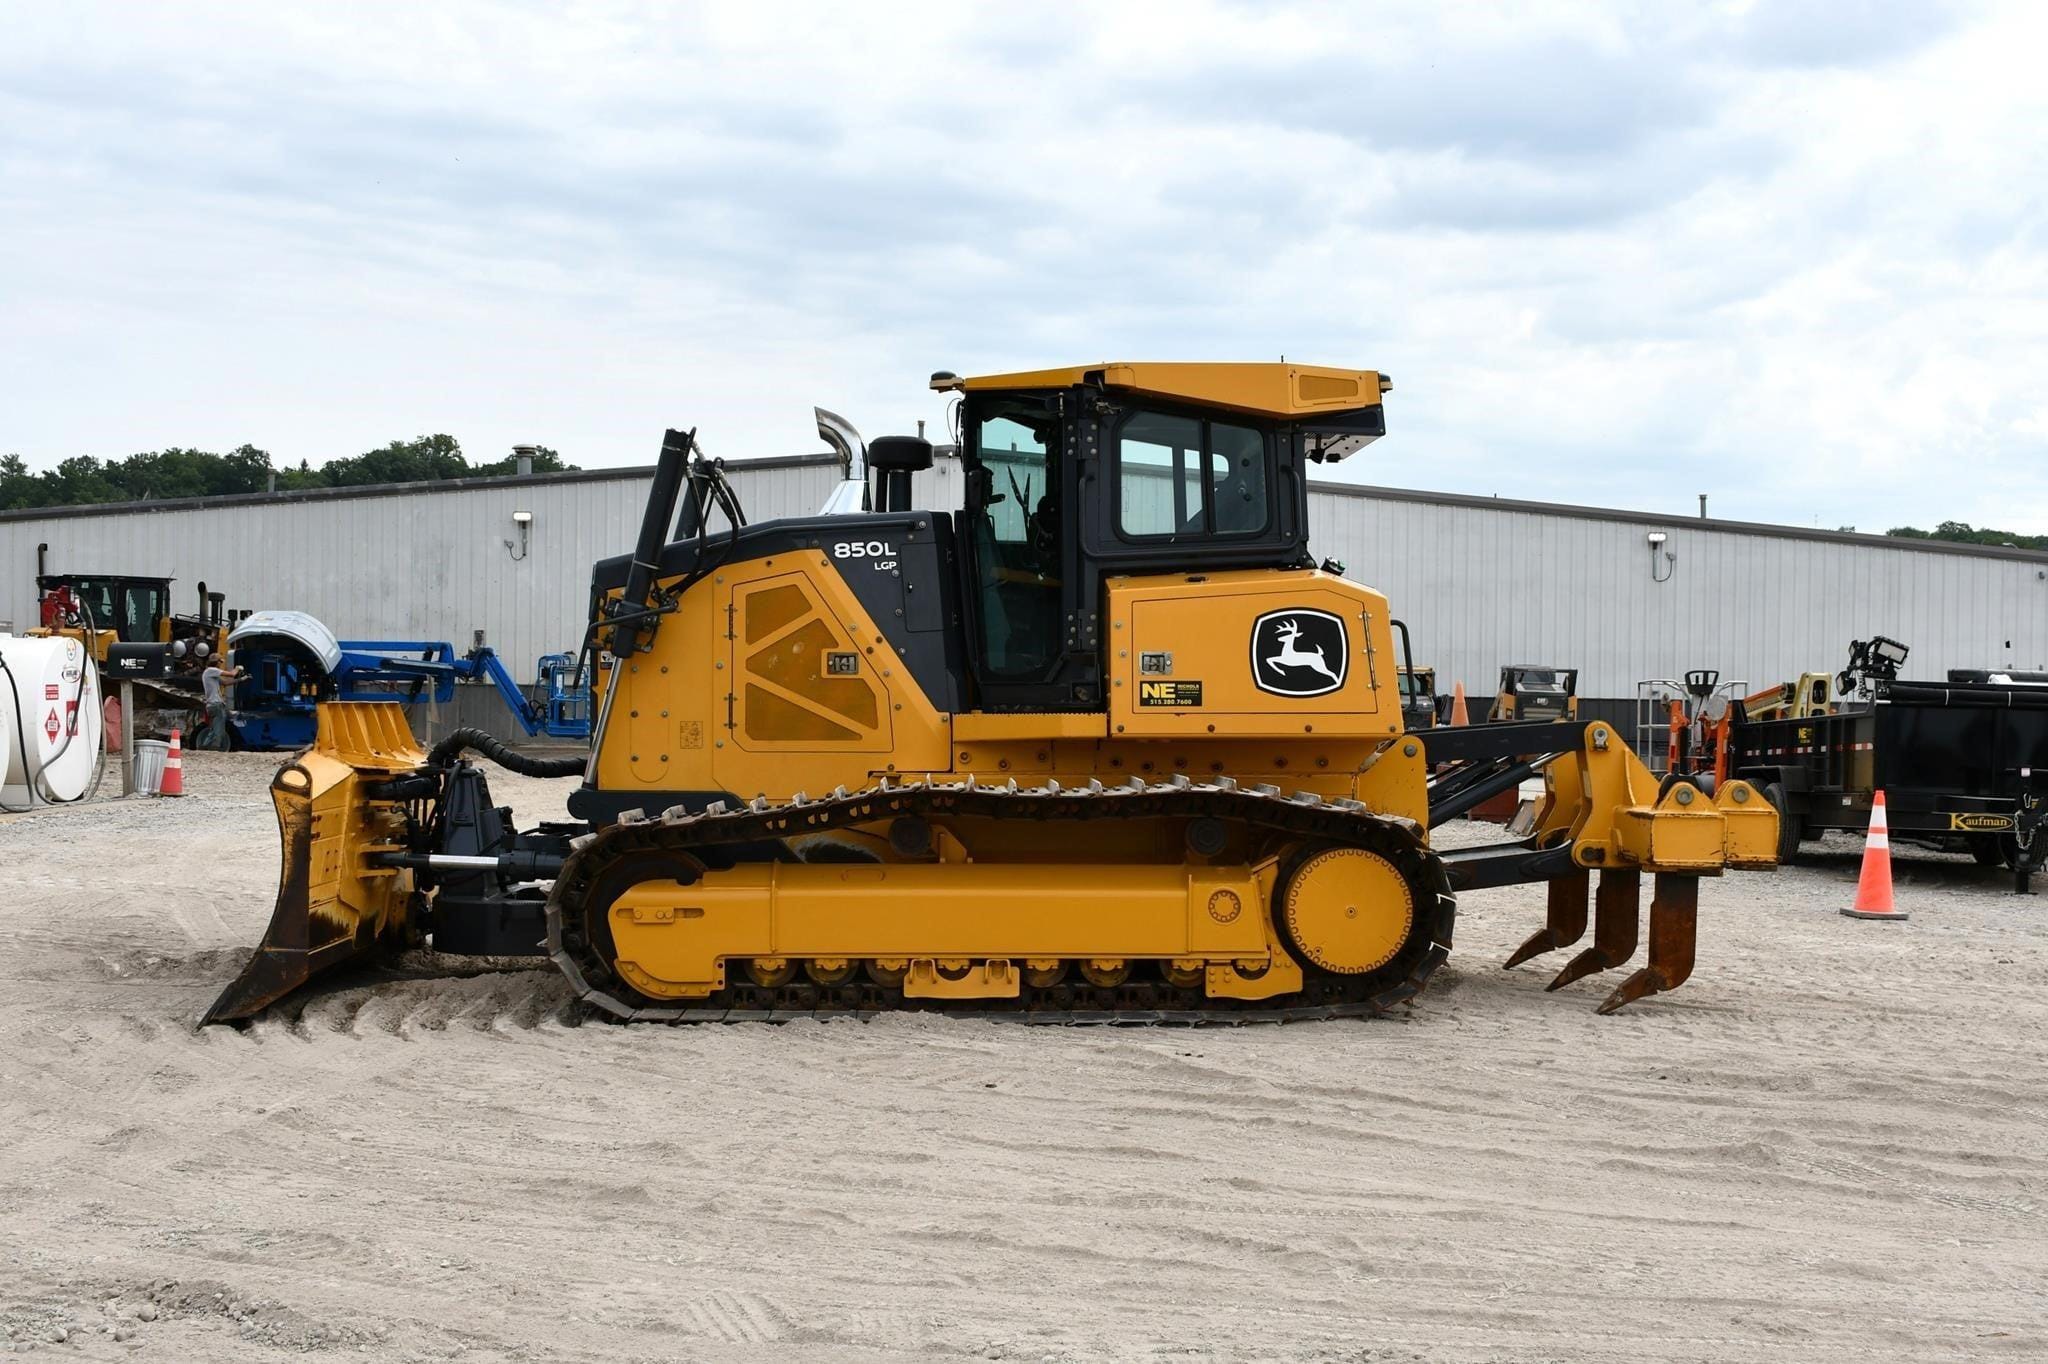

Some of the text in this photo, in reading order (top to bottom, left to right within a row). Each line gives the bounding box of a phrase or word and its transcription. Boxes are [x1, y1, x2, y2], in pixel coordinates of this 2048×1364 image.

[834, 541, 897, 558] 850L
[874, 561, 897, 570] LGP
[121, 658, 137, 666] NE
[1142, 683, 1176, 698] NE
[1950, 812, 2008, 831] Kaufman
